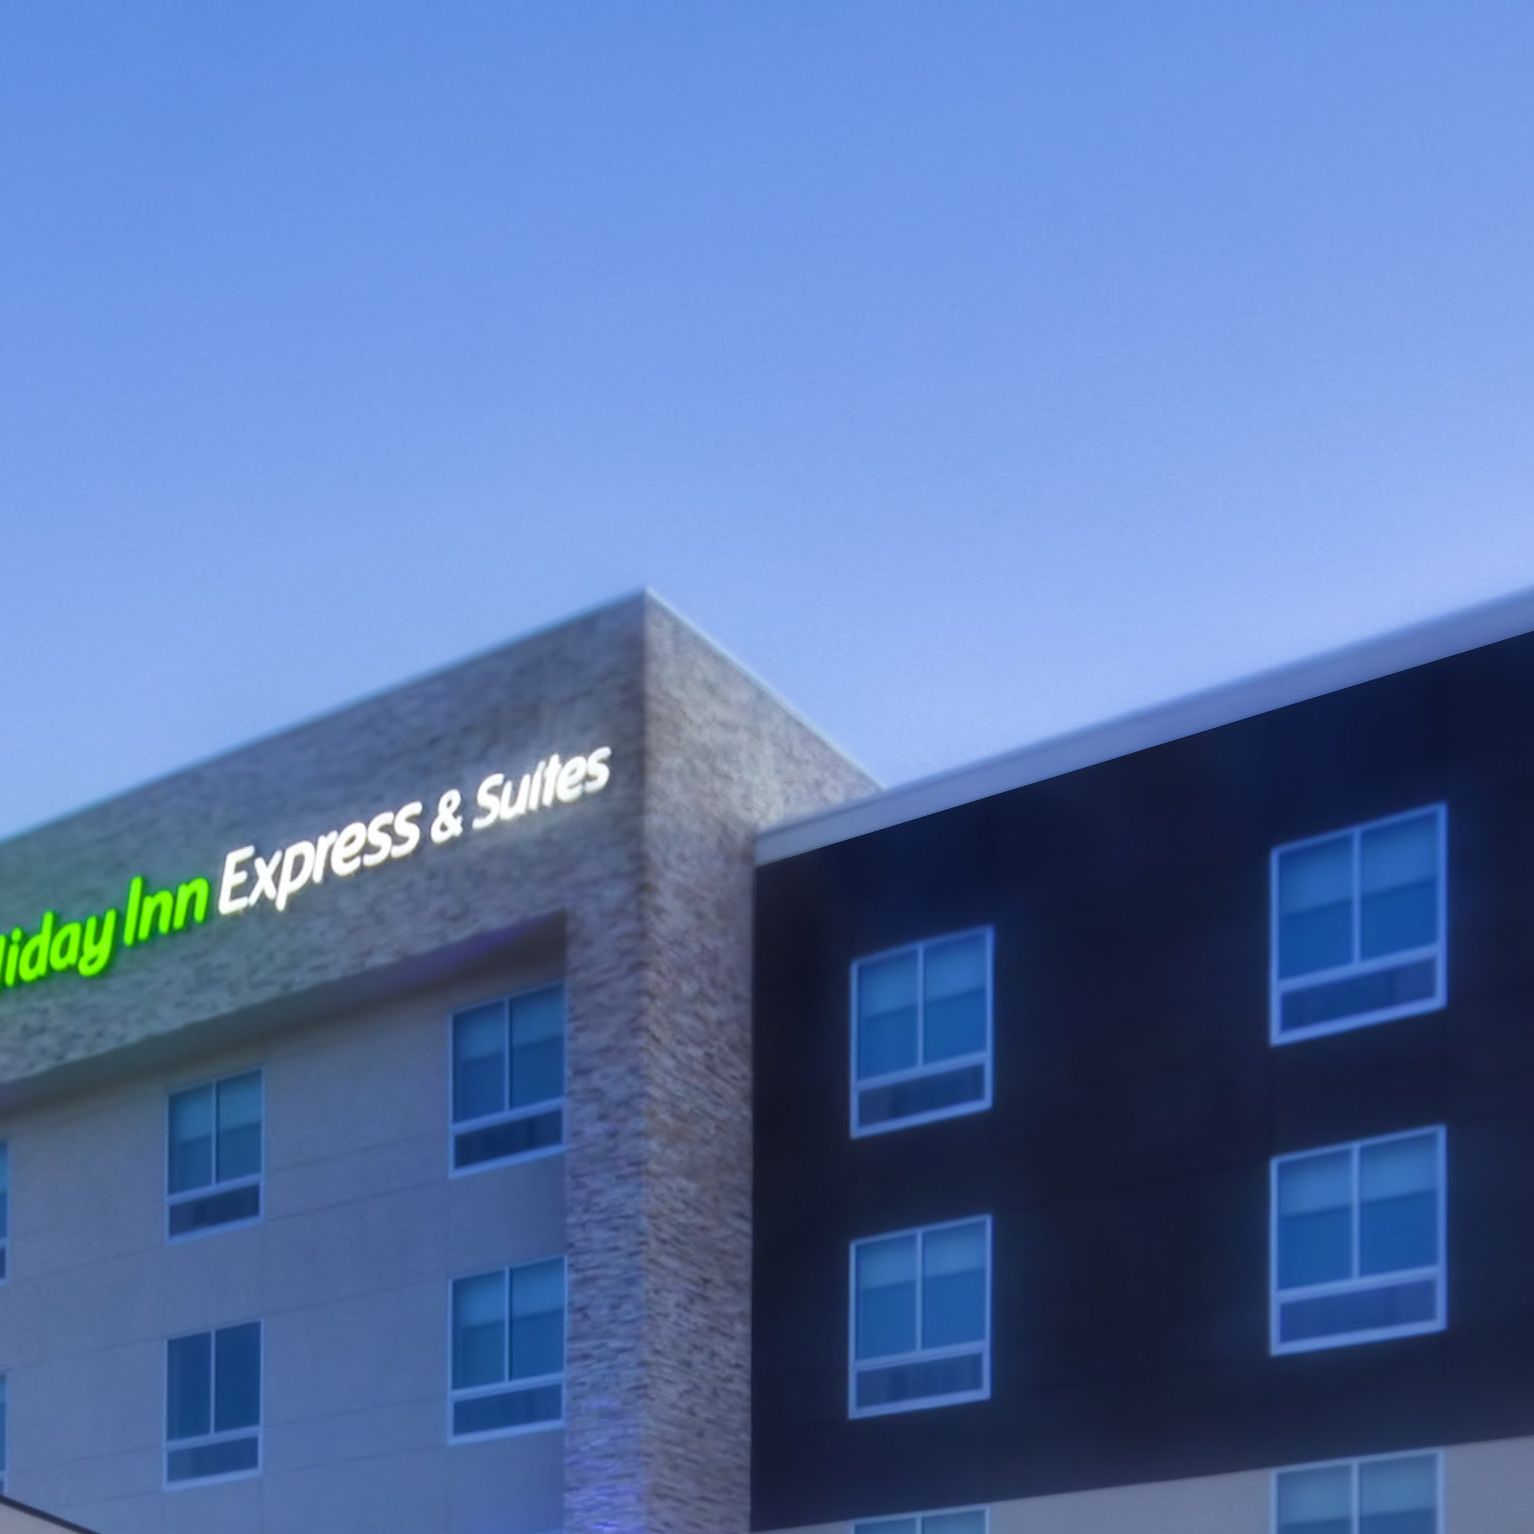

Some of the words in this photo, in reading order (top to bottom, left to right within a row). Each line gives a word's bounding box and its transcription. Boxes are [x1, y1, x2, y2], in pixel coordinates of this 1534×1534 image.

[123, 875, 210, 948] Inn
[217, 800, 423, 915] Express
[430, 788, 464, 844] &
[472, 746, 612, 830] Suites
